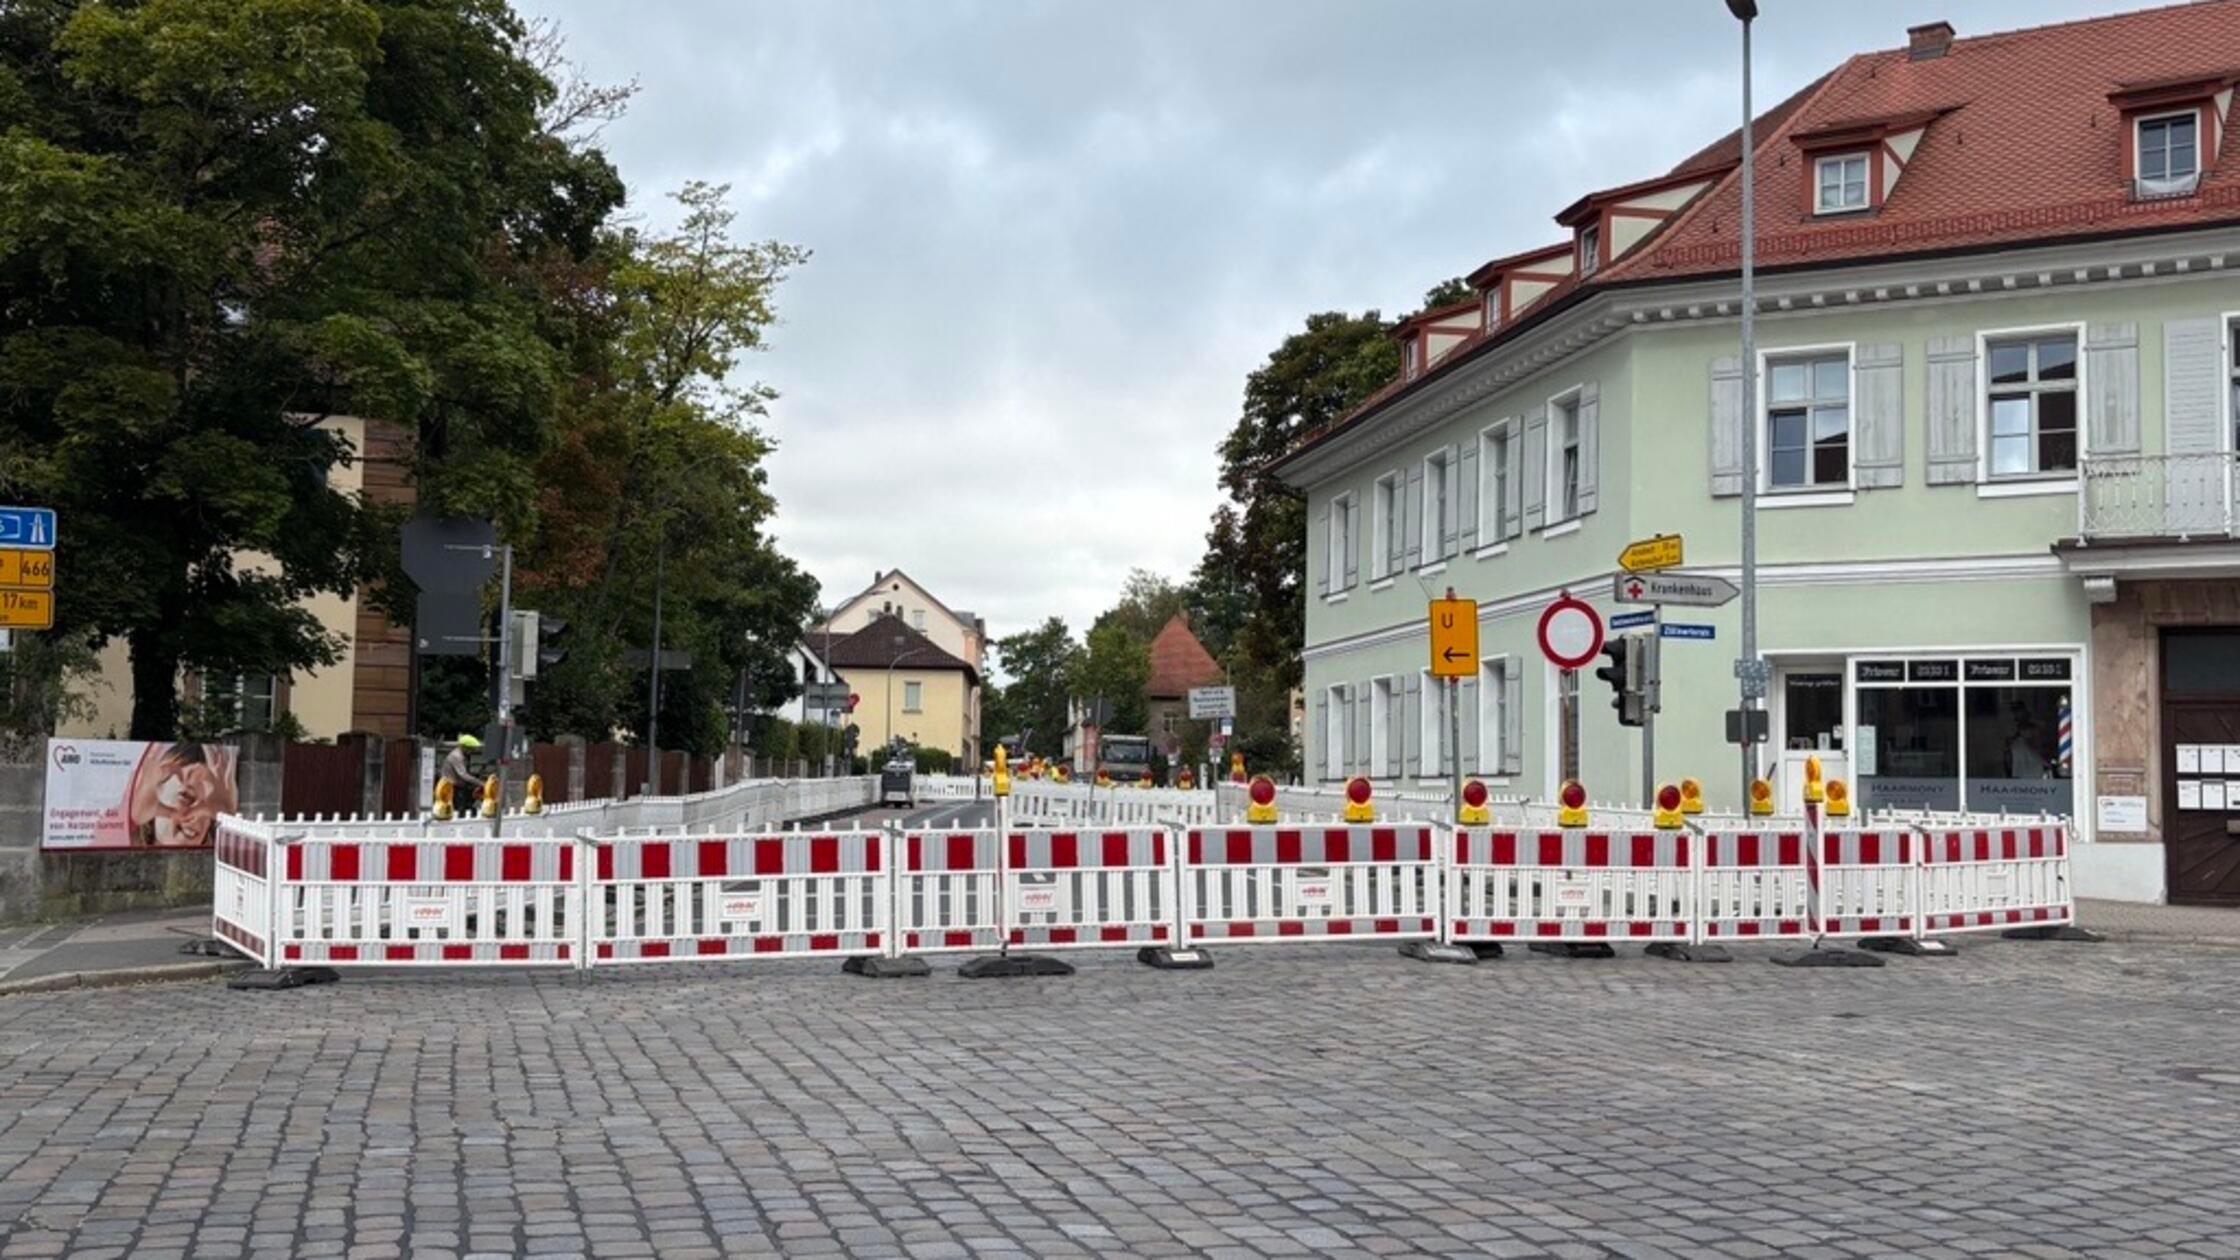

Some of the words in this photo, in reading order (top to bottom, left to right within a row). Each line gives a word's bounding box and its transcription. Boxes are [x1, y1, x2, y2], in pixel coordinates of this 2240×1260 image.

[22, 560, 49, 577] 466
[1651, 582, 1713, 597] Krankenhaus
[3, 593, 18, 609] 17
[19, 595, 38, 610] km
[1441, 612, 1453, 629] U
